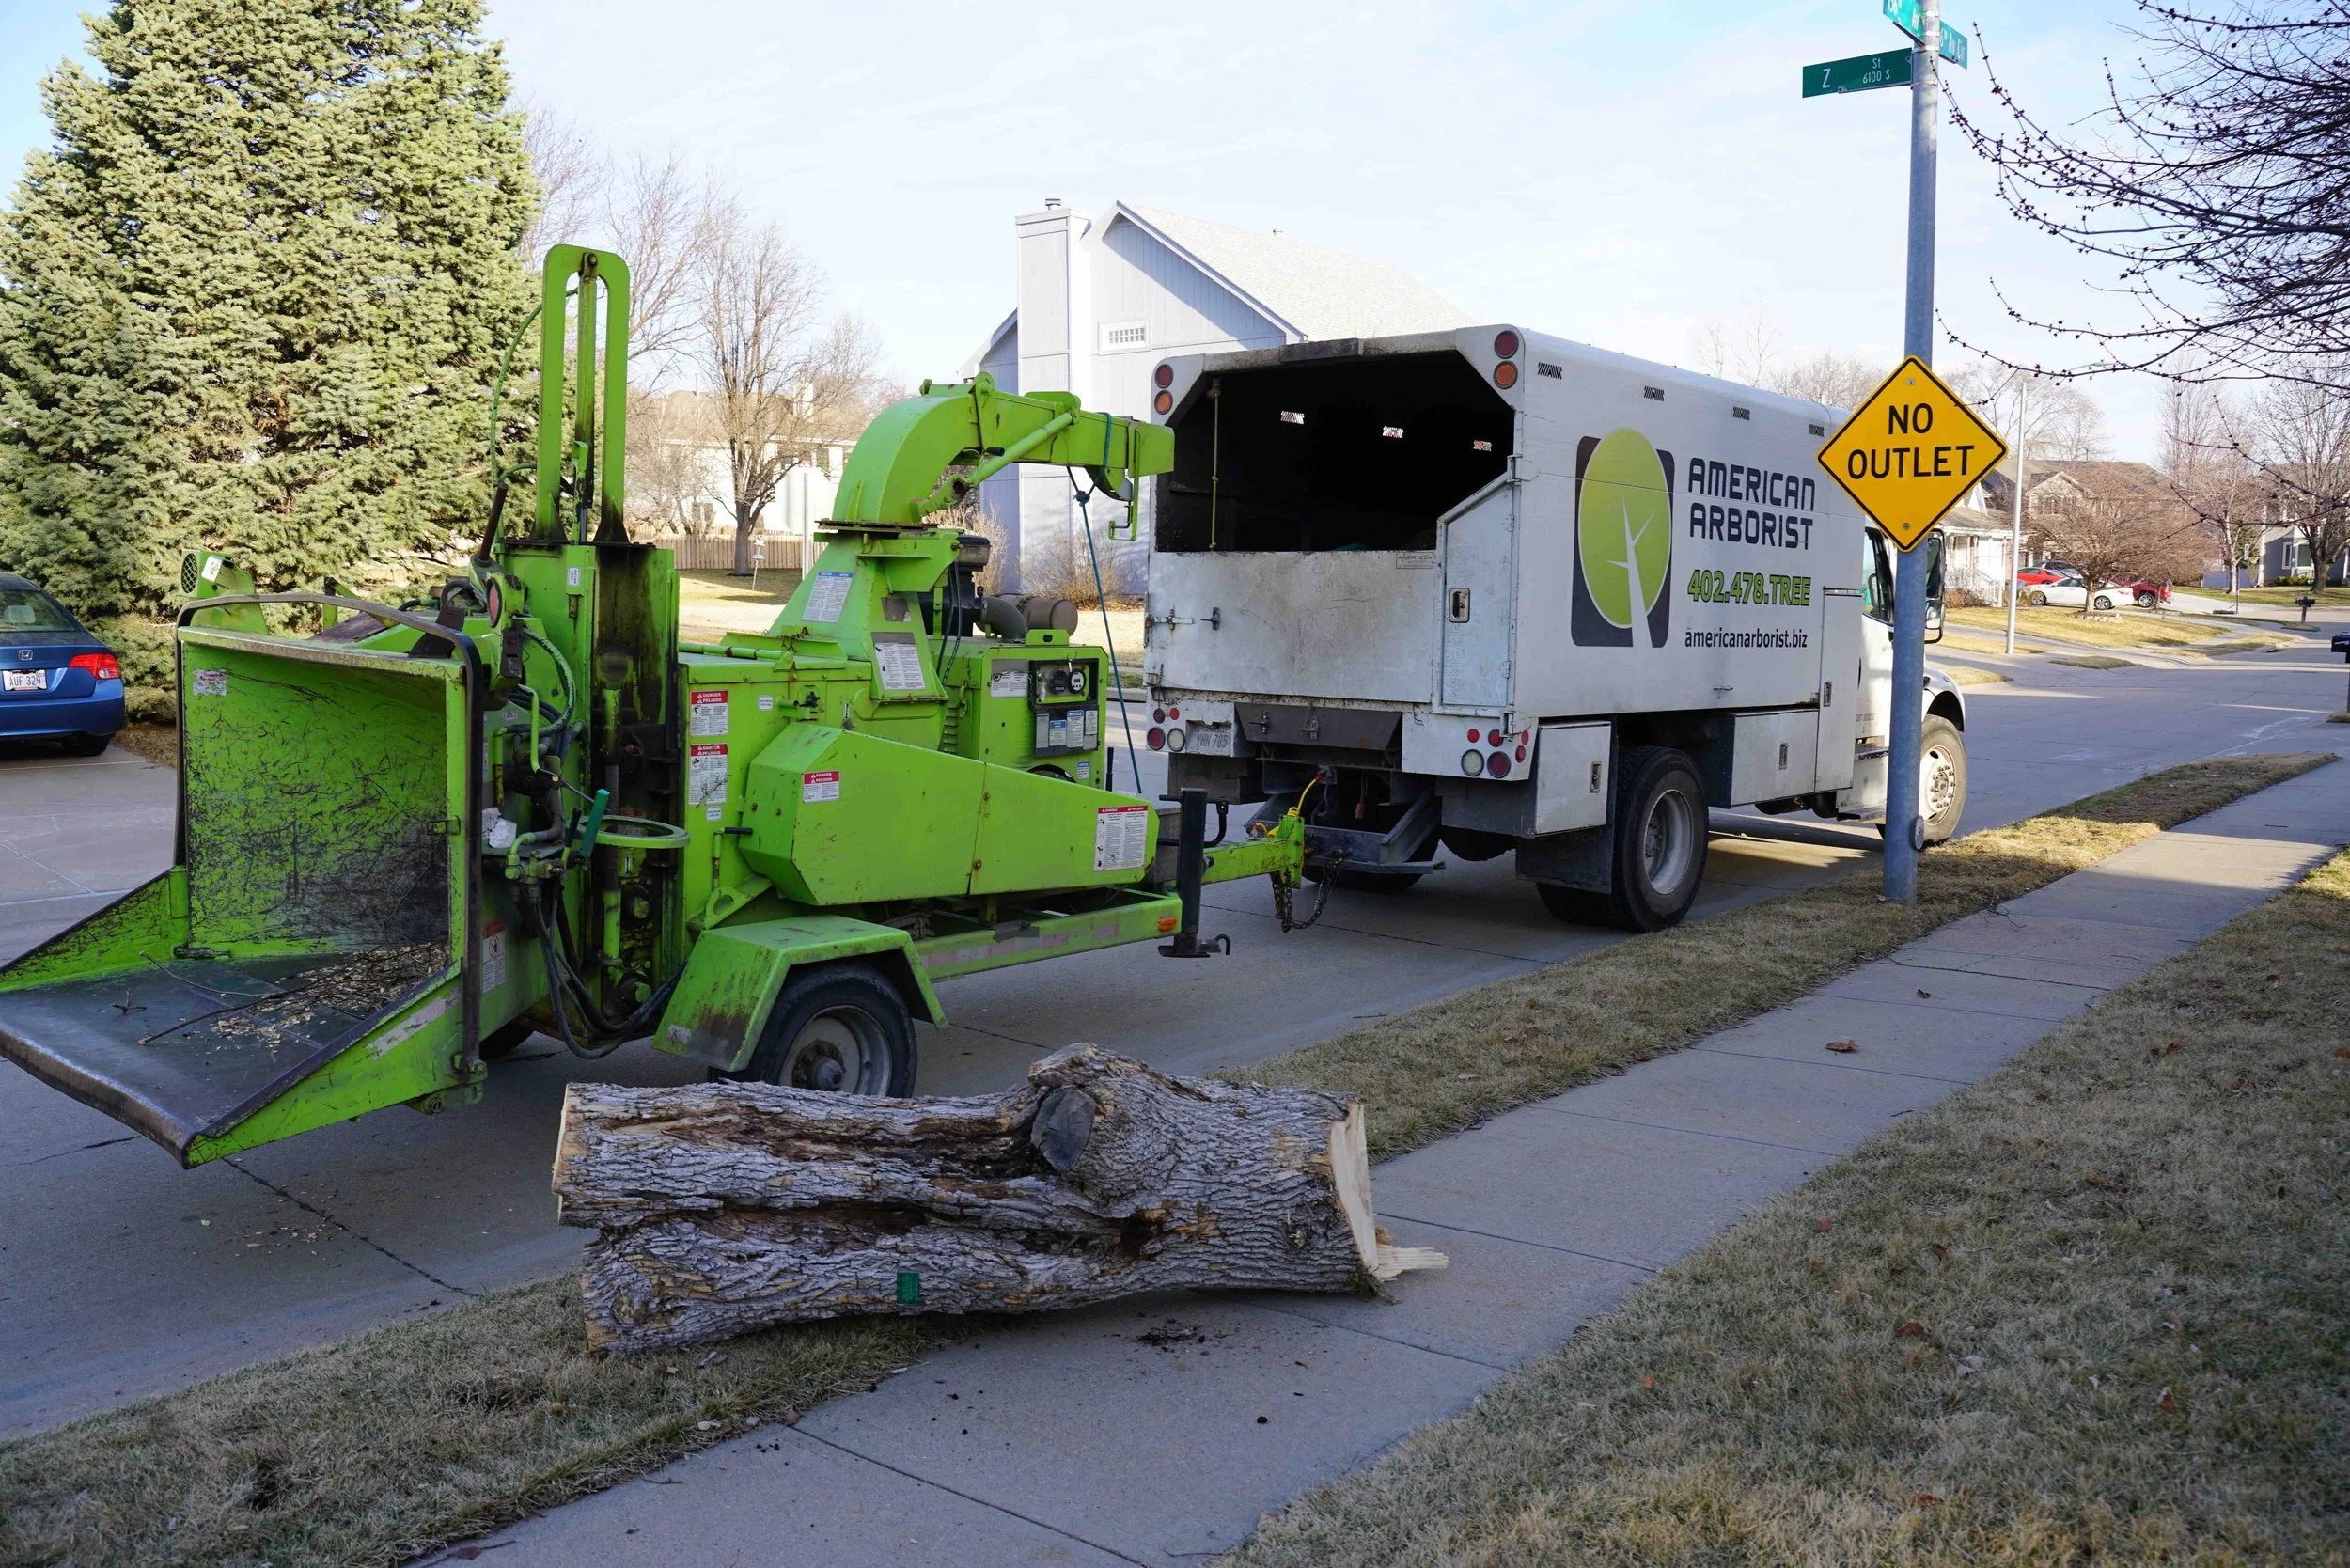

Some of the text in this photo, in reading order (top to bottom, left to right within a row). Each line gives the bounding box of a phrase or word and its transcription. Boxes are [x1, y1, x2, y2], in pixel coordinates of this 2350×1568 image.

[1822, 57, 1881, 89] Z St
[1862, 69, 1890, 84] 6100 S
[1888, 402, 1934, 435] NO
[1847, 445, 1975, 479] OUTLET
[1688, 457, 1815, 511] AMERICAN
[1689, 502, 1813, 550] ARBORIST
[1687, 569, 1811, 606] 402.478.TREE
[1684, 627, 1808, 648] americanarborist.biz
[9, 675, 41, 686] AUF 329
